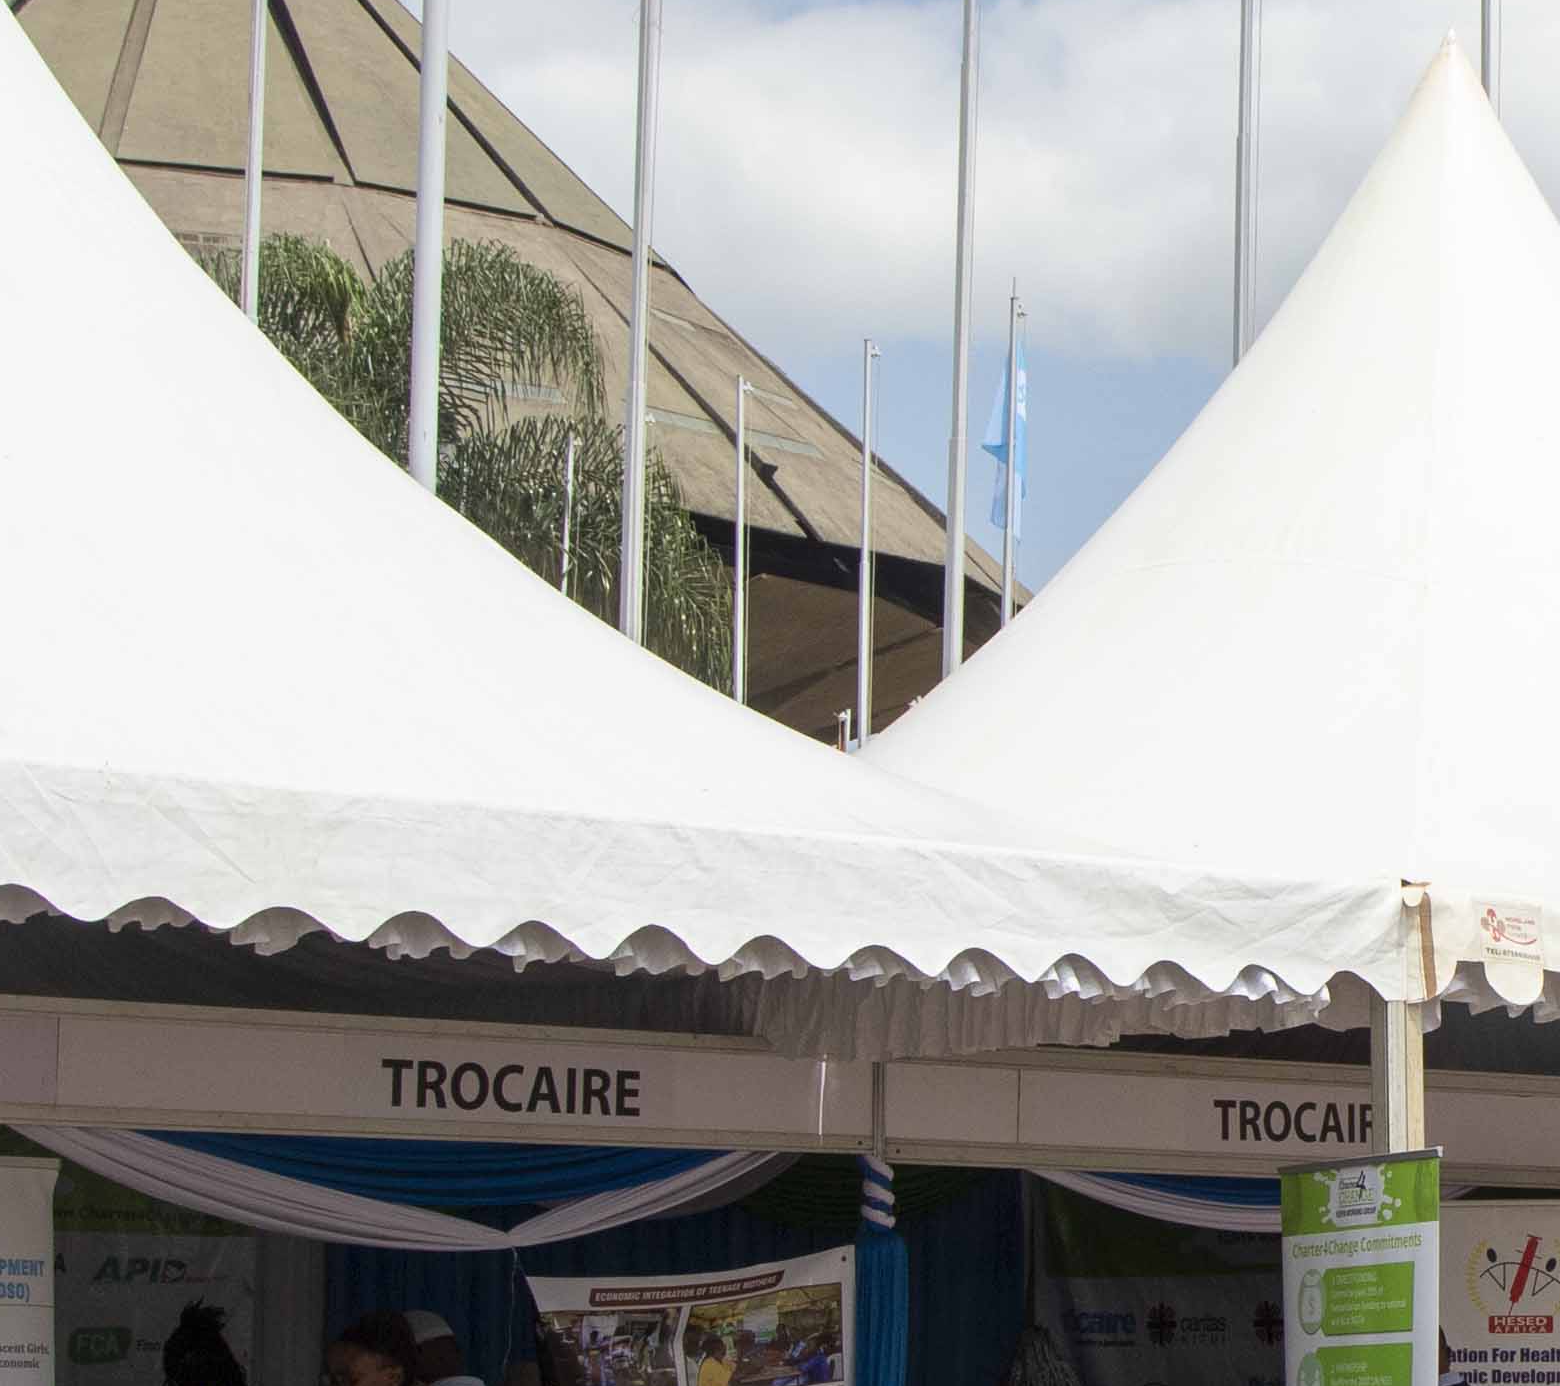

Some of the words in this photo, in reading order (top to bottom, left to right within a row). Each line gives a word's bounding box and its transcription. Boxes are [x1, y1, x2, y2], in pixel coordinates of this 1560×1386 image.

[382, 1058, 640, 1117] TROCAIRE
[595, 1292, 640, 1302] ECONOMIC
[643, 1289, 694, 1301] INTEGRATION
[696, 1286, 706, 1295] OF
[1495, 1316, 1547, 1326] HESED
[1496, 1325, 1547, 1333] AFRICA
[1492, 1348, 1516, 1362] For
